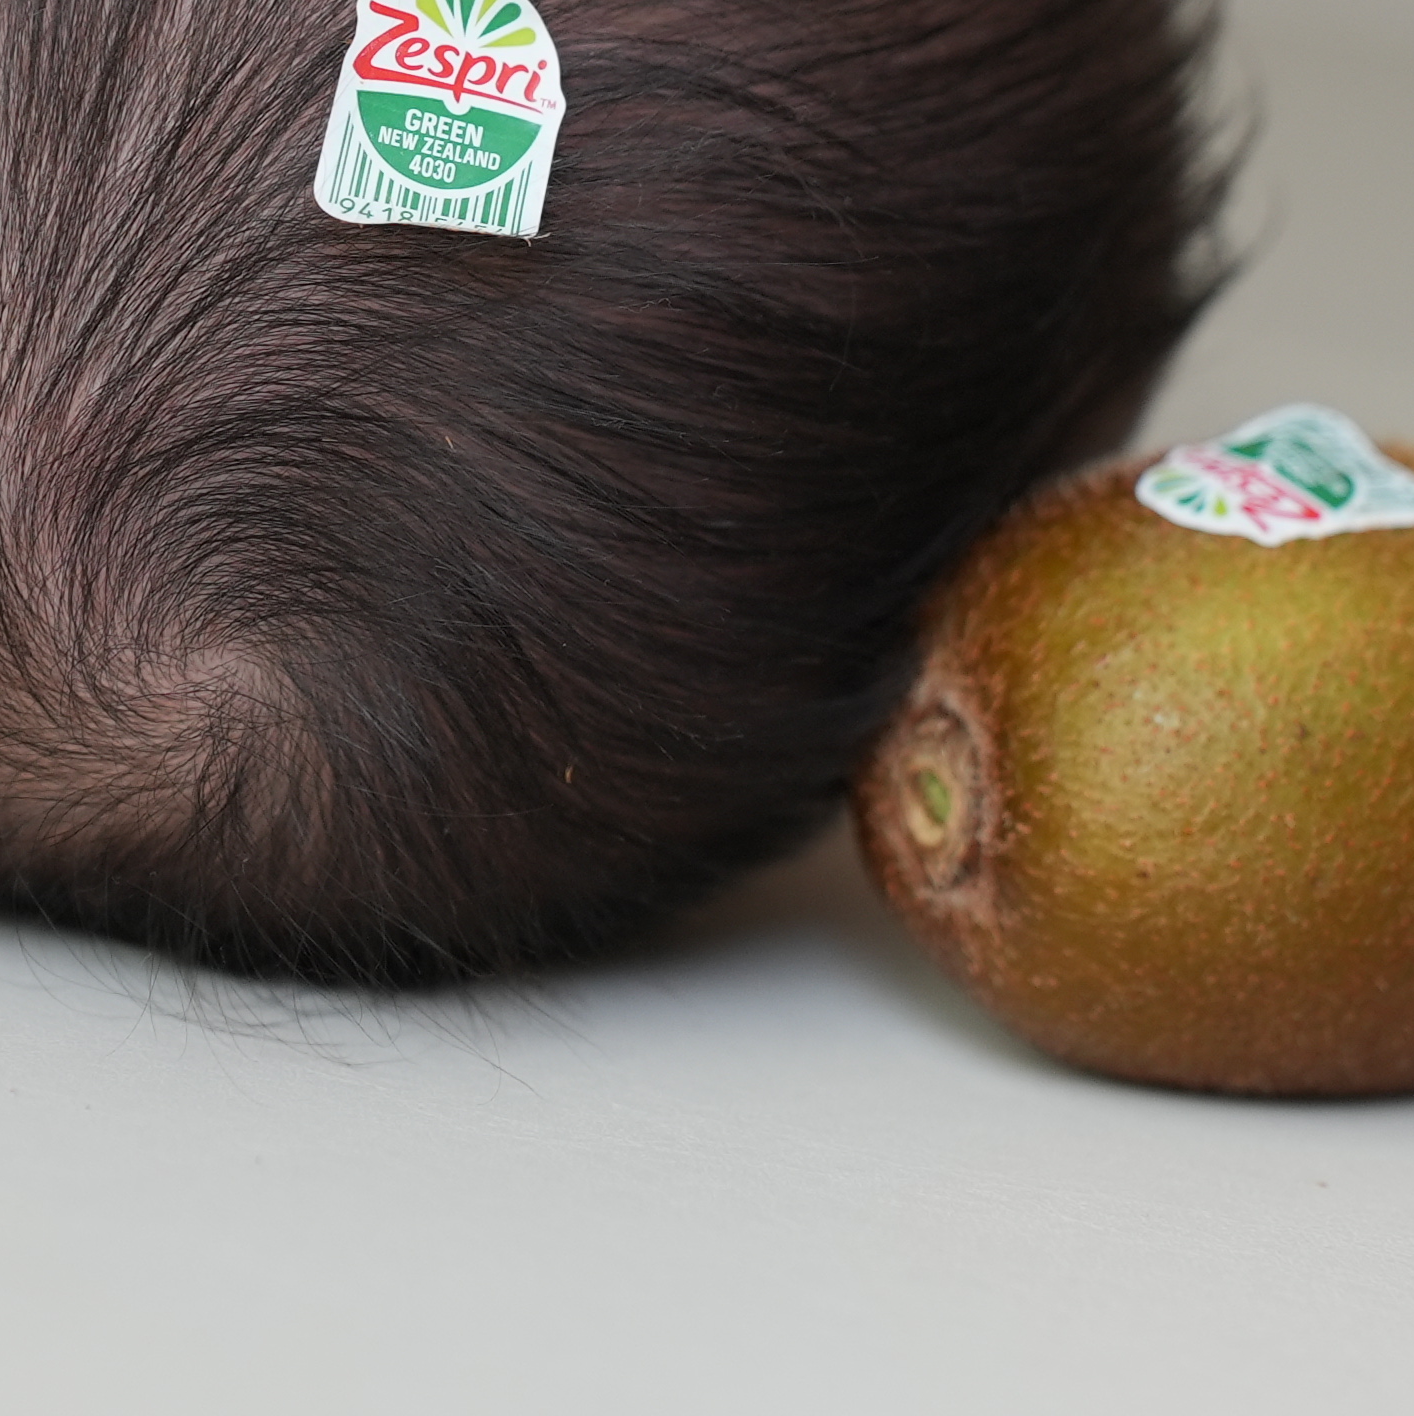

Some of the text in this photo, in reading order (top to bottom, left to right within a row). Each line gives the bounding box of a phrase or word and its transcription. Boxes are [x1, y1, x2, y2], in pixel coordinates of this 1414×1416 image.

[353, 0, 548, 114] Zespri
[378, 126, 501, 171] NEW ZEALAND
[404, 108, 484, 147] GREEN
[408, 154, 456, 183] 4030
